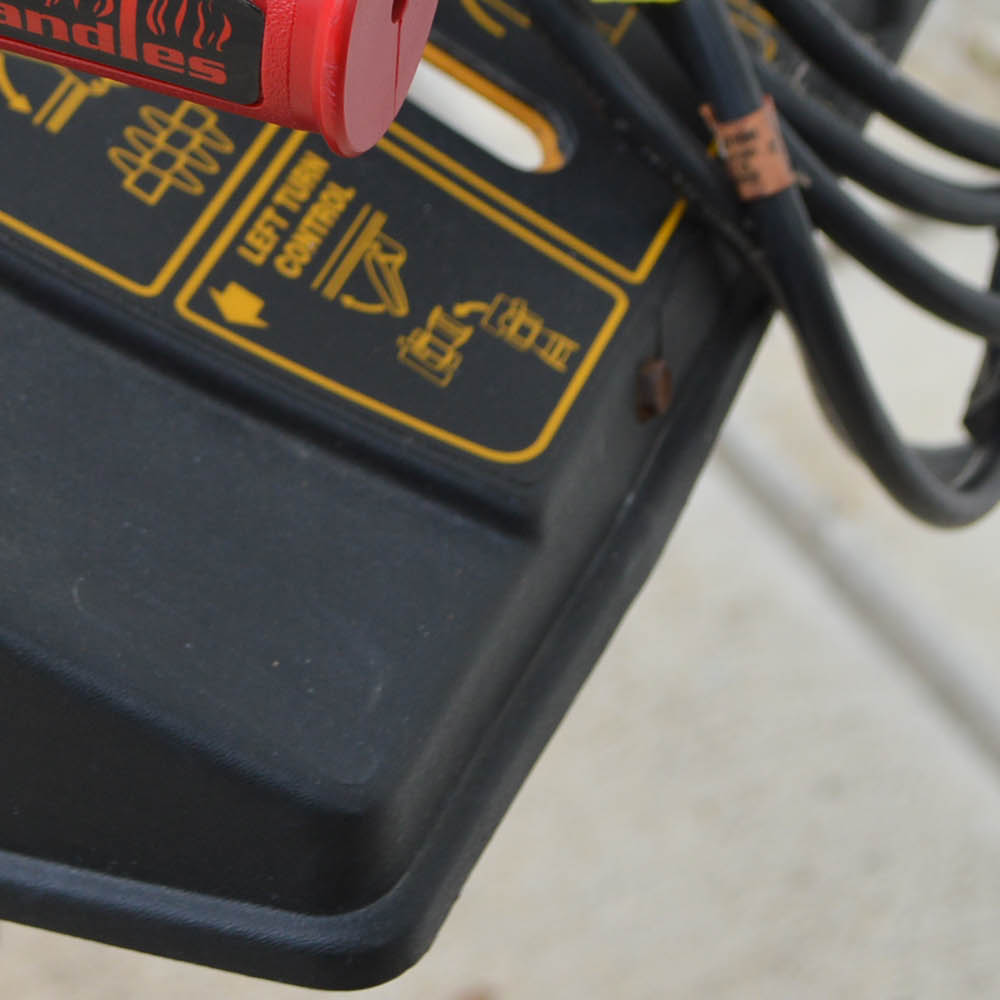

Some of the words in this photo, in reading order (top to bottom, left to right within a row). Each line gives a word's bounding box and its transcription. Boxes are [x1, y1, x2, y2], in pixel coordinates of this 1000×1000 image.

[236, 204, 290, 266] LEFT
[272, 149, 330, 214] TURN
[273, 180, 357, 279] CONTROL
